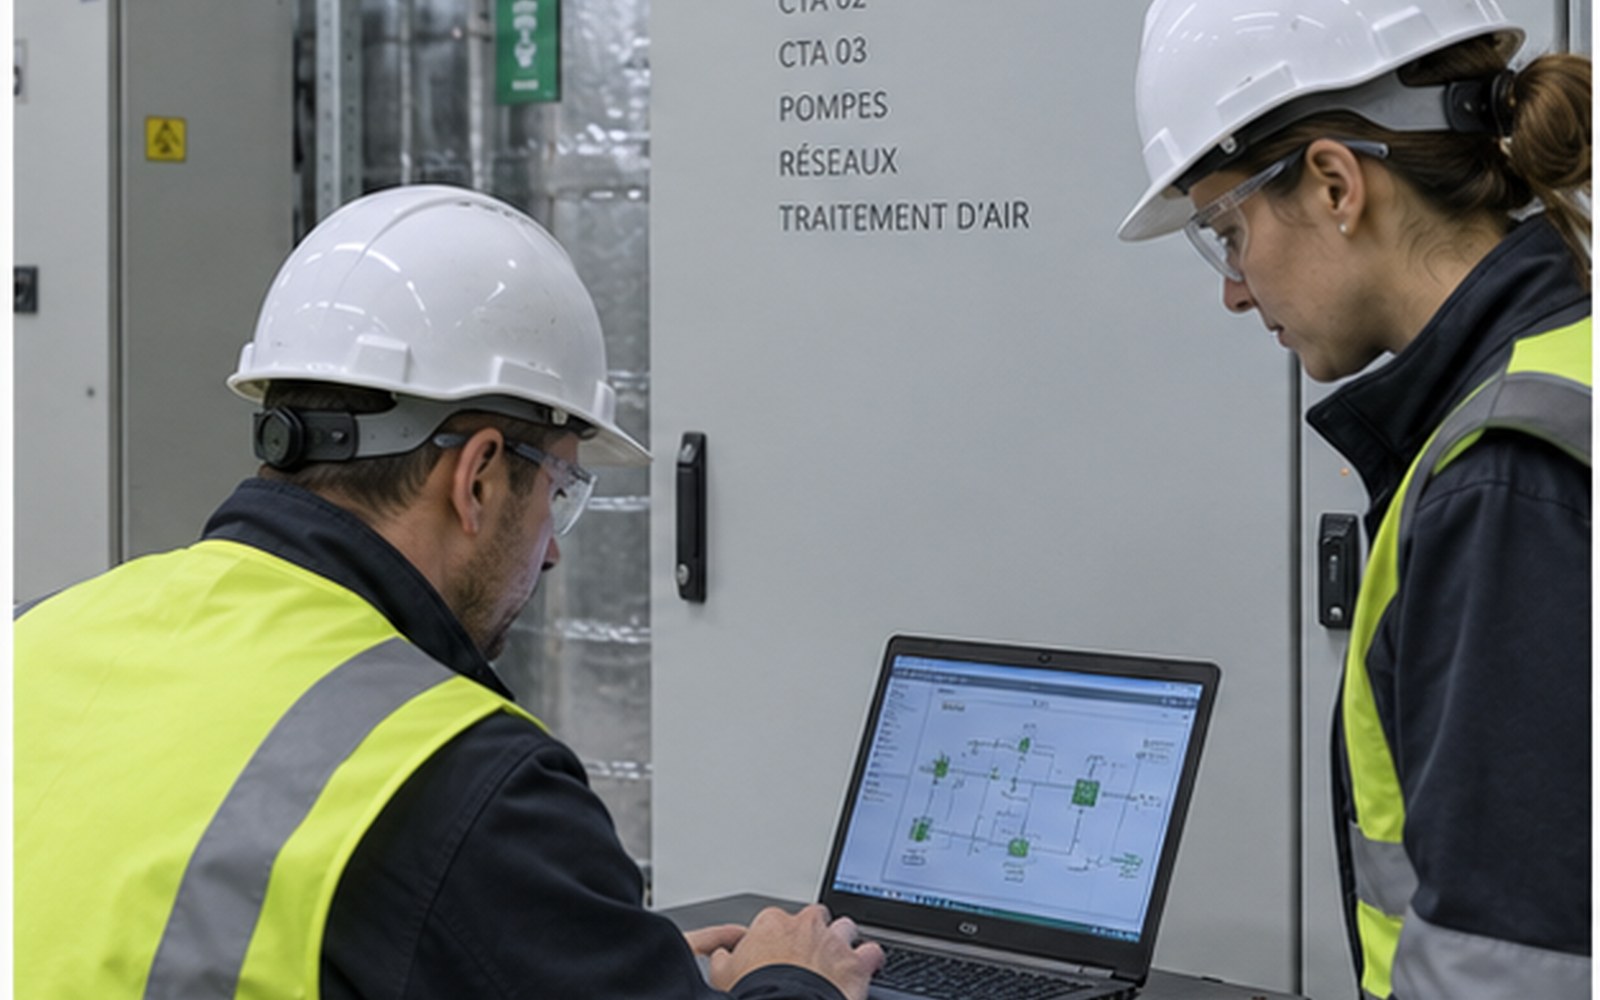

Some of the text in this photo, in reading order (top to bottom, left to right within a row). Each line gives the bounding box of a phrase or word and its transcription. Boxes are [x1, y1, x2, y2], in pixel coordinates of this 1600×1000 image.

[779, 36, 867, 68] CTA 03
[780, 91, 888, 121] POMPES
[780, 143, 898, 176] RÉSEAUX
[779, 202, 947, 231] TRAITEMENT
